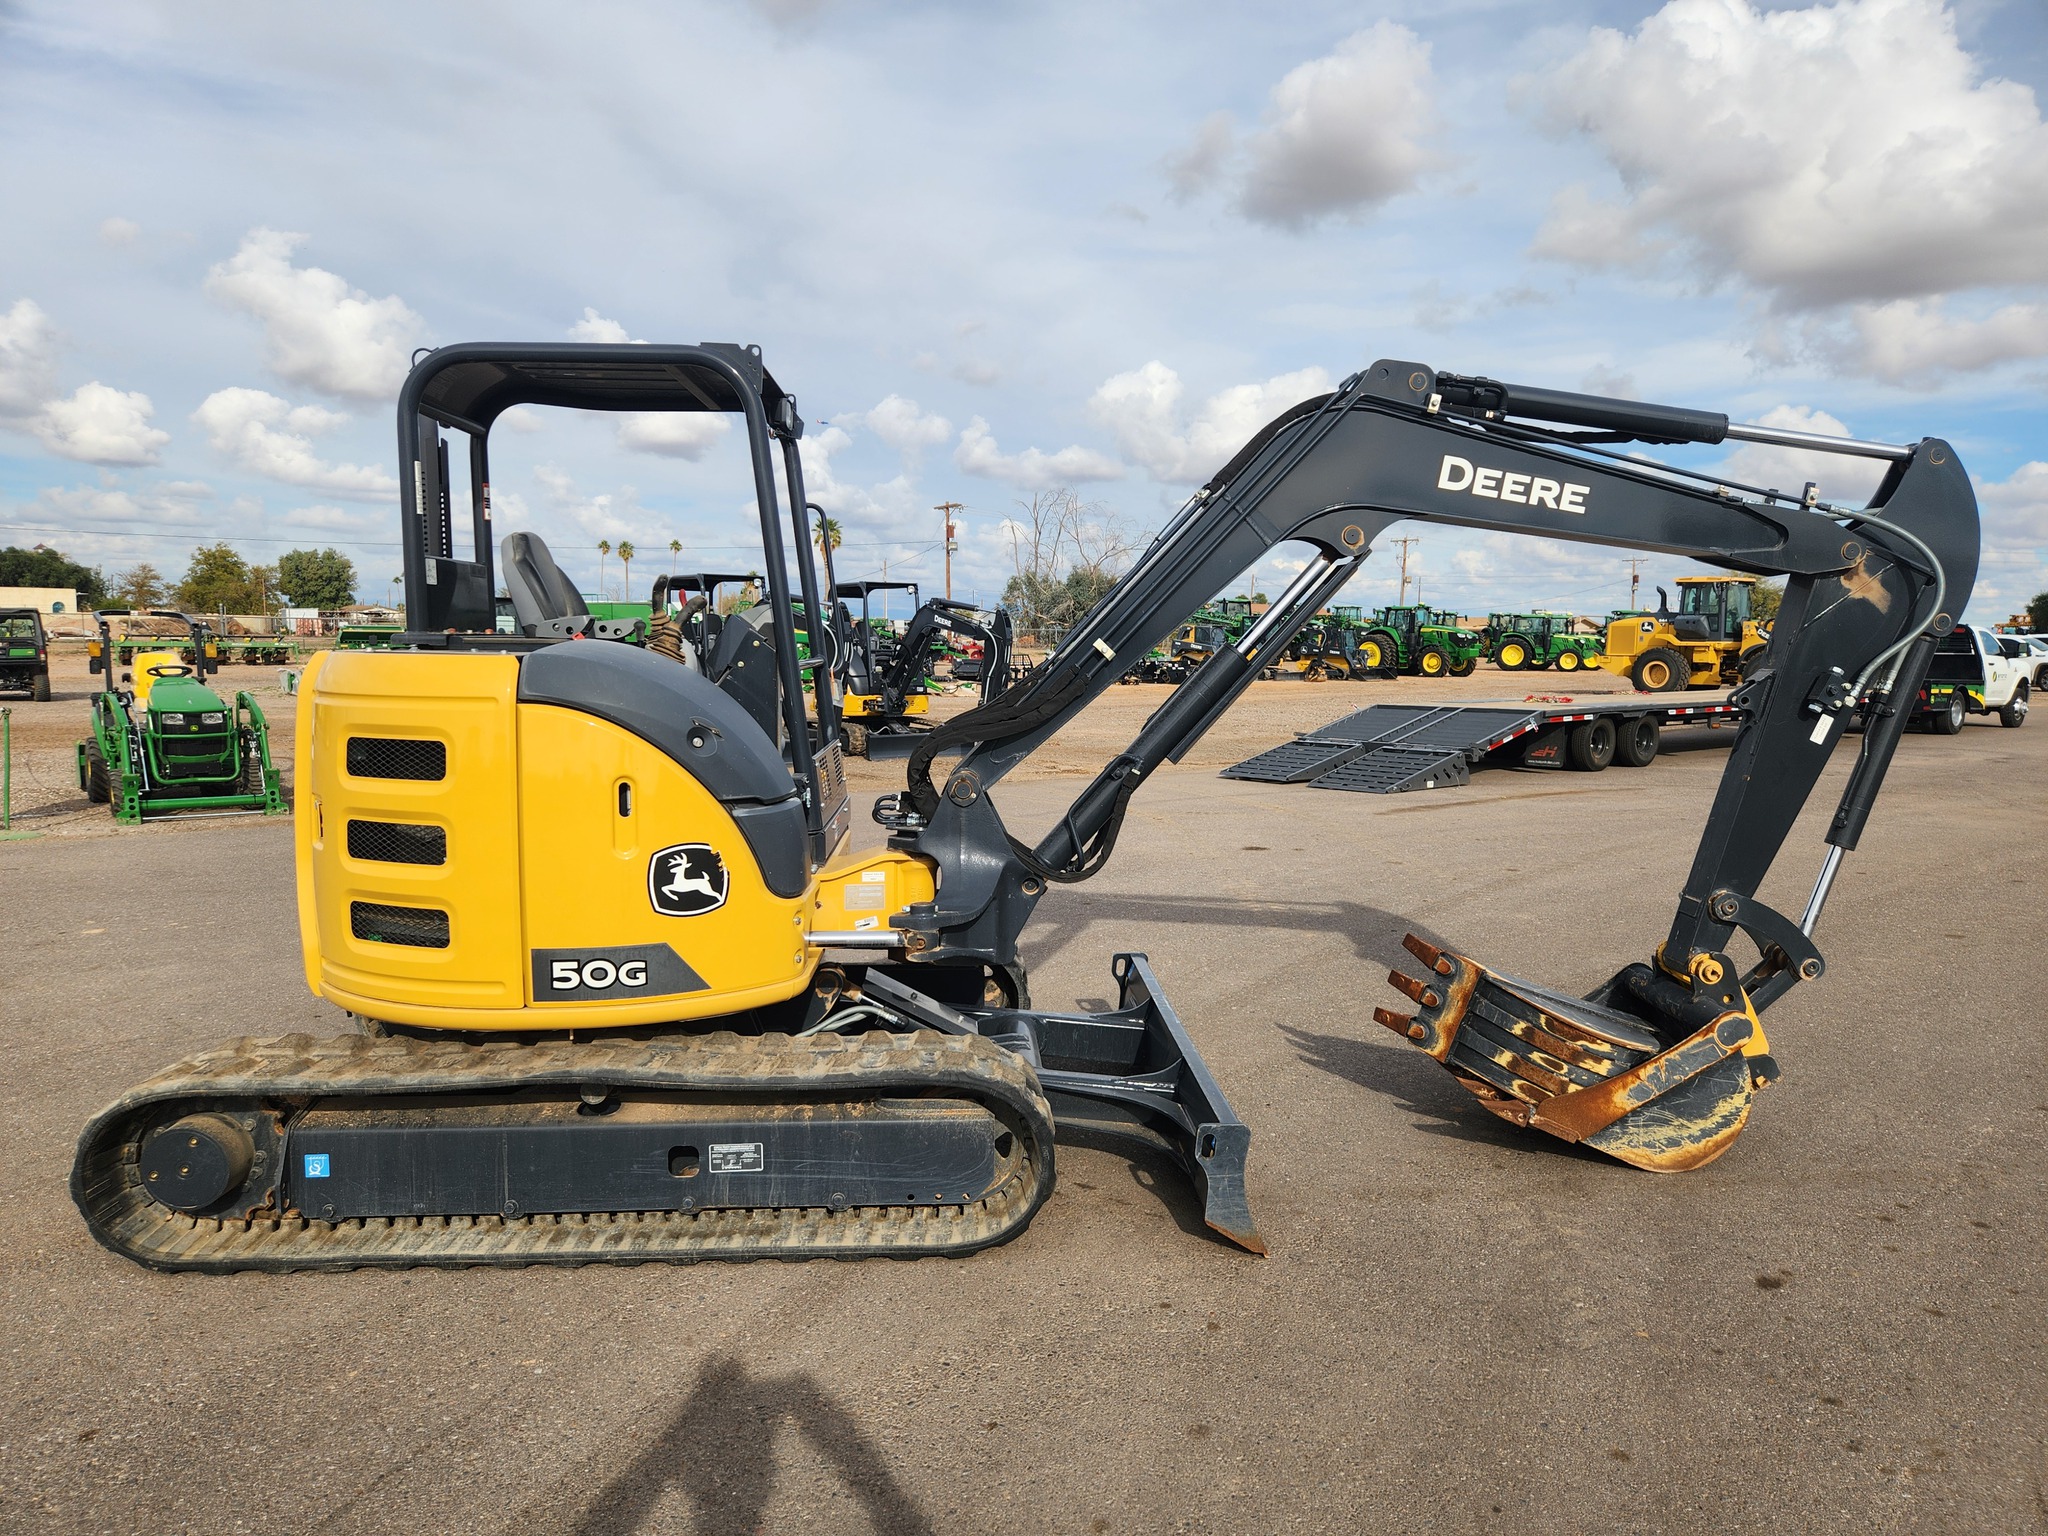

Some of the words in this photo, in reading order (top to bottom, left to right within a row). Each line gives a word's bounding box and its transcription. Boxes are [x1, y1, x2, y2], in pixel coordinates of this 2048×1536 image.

[1437, 454, 1591, 514] DEERE
[934, 614, 952, 627] DEERE
[551, 957, 649, 992] 50G
